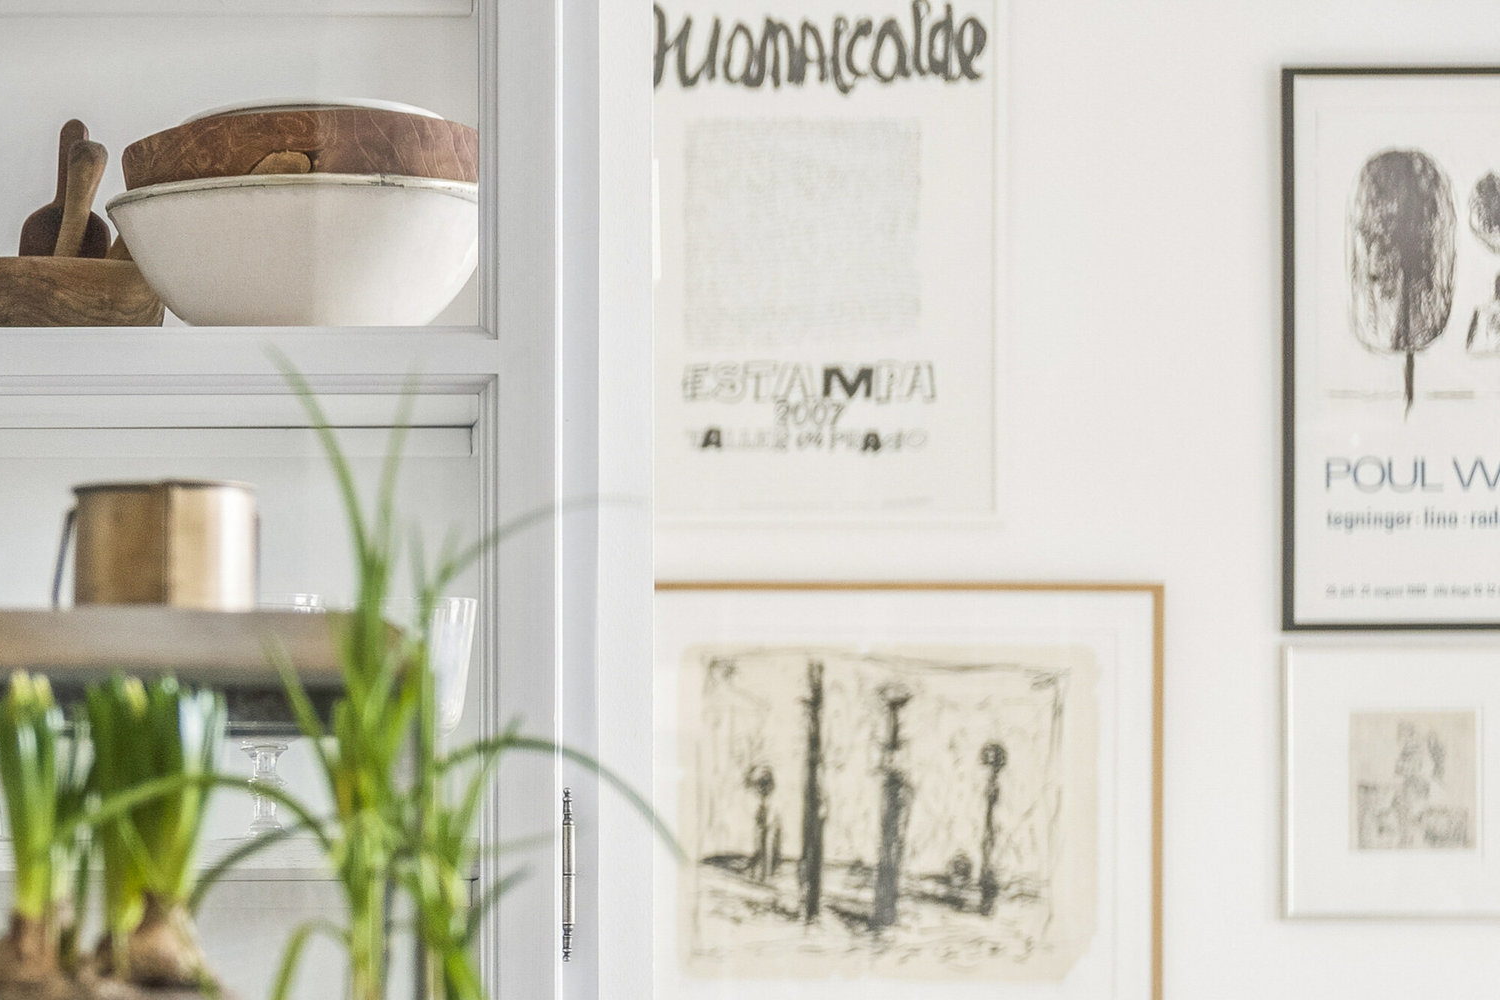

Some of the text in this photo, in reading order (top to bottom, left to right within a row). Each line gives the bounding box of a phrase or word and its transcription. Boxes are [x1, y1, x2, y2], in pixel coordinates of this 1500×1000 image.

[682, 360, 936, 403] ESTAMPA
[774, 400, 845, 428] 2007
[1325, 456, 1444, 493] POUL
